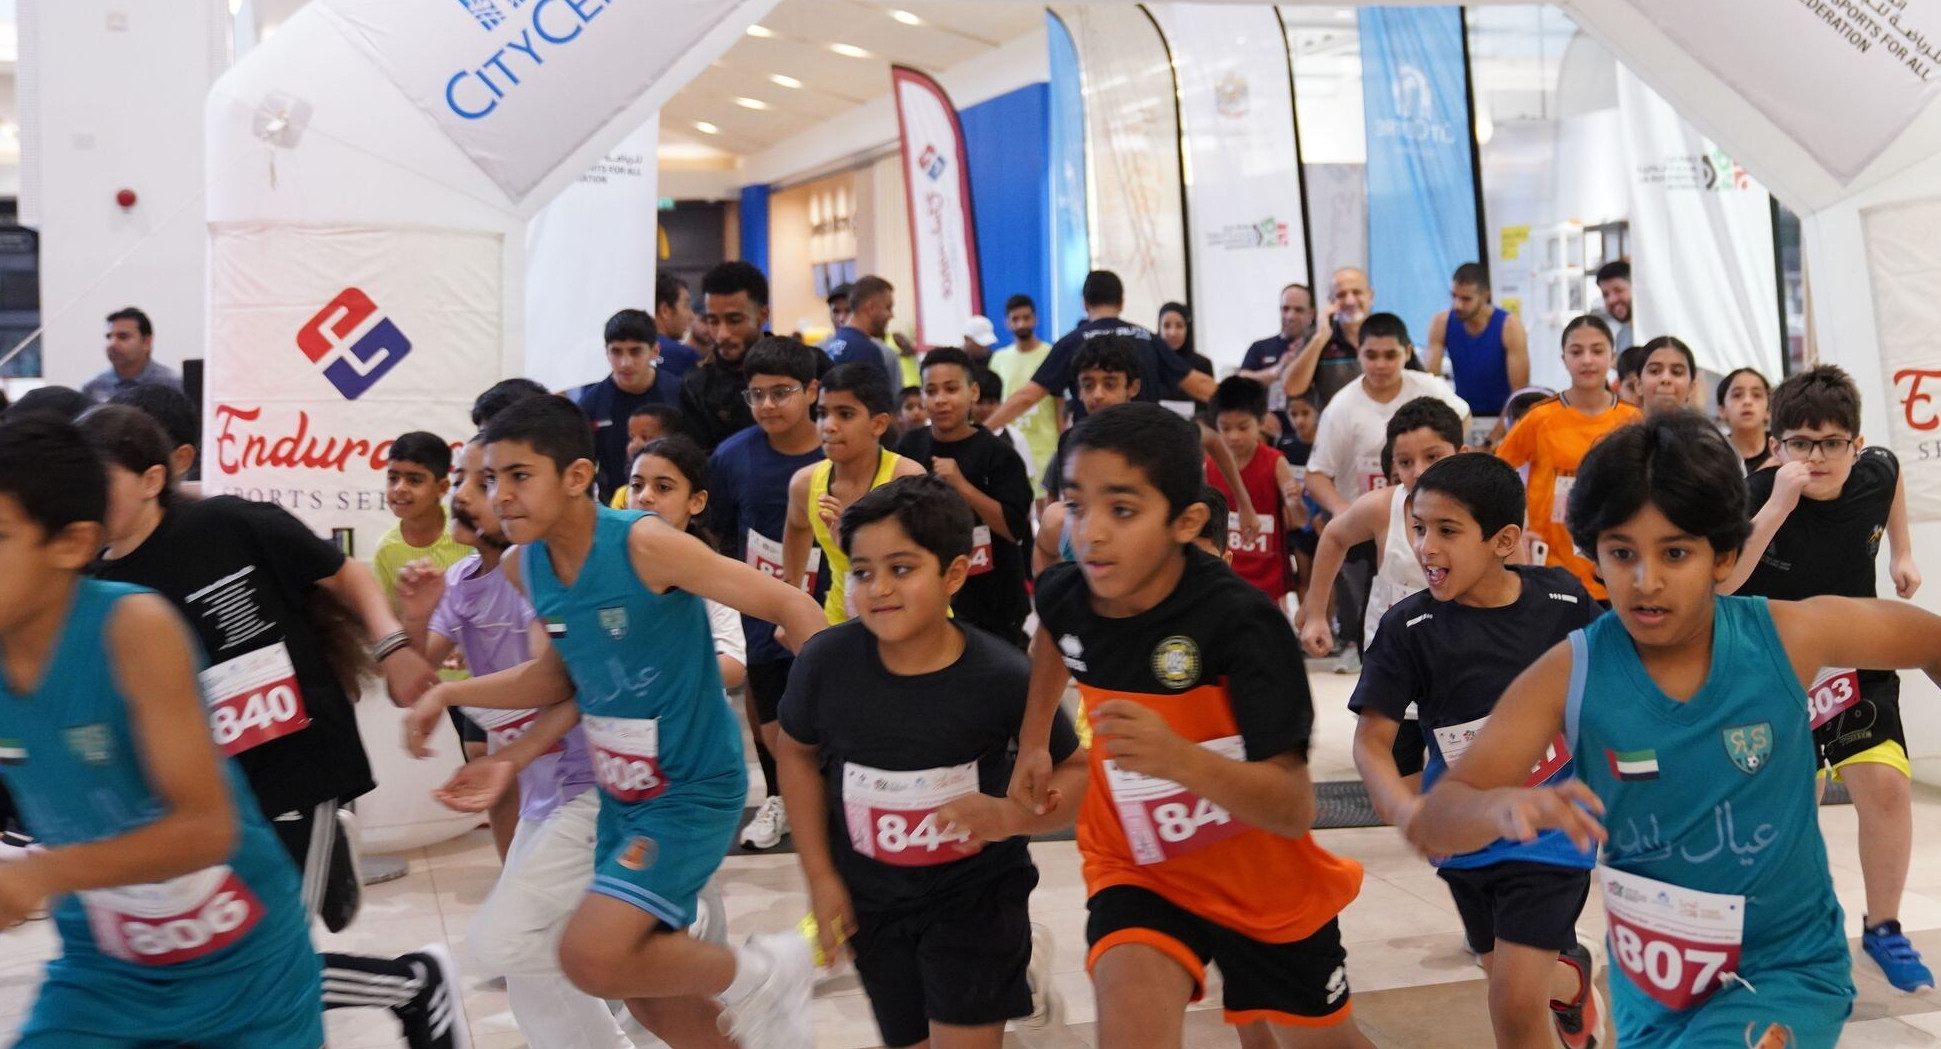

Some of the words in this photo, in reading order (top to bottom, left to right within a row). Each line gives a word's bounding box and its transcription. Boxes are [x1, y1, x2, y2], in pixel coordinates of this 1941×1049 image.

[1801, 0, 1872, 54] DERATION
[1880, 33, 1908, 61] FOR
[1906, 57, 1931, 82] ALL
[446, 0, 611, 119] CITYCE
[216, 404, 463, 474] Endura
[1919, 441, 1941, 461] S
[209, 684, 298, 745] 840
[1152, 798, 1231, 843] 84
[123, 891, 250, 956] 806
[1615, 924, 1728, 995] 807
